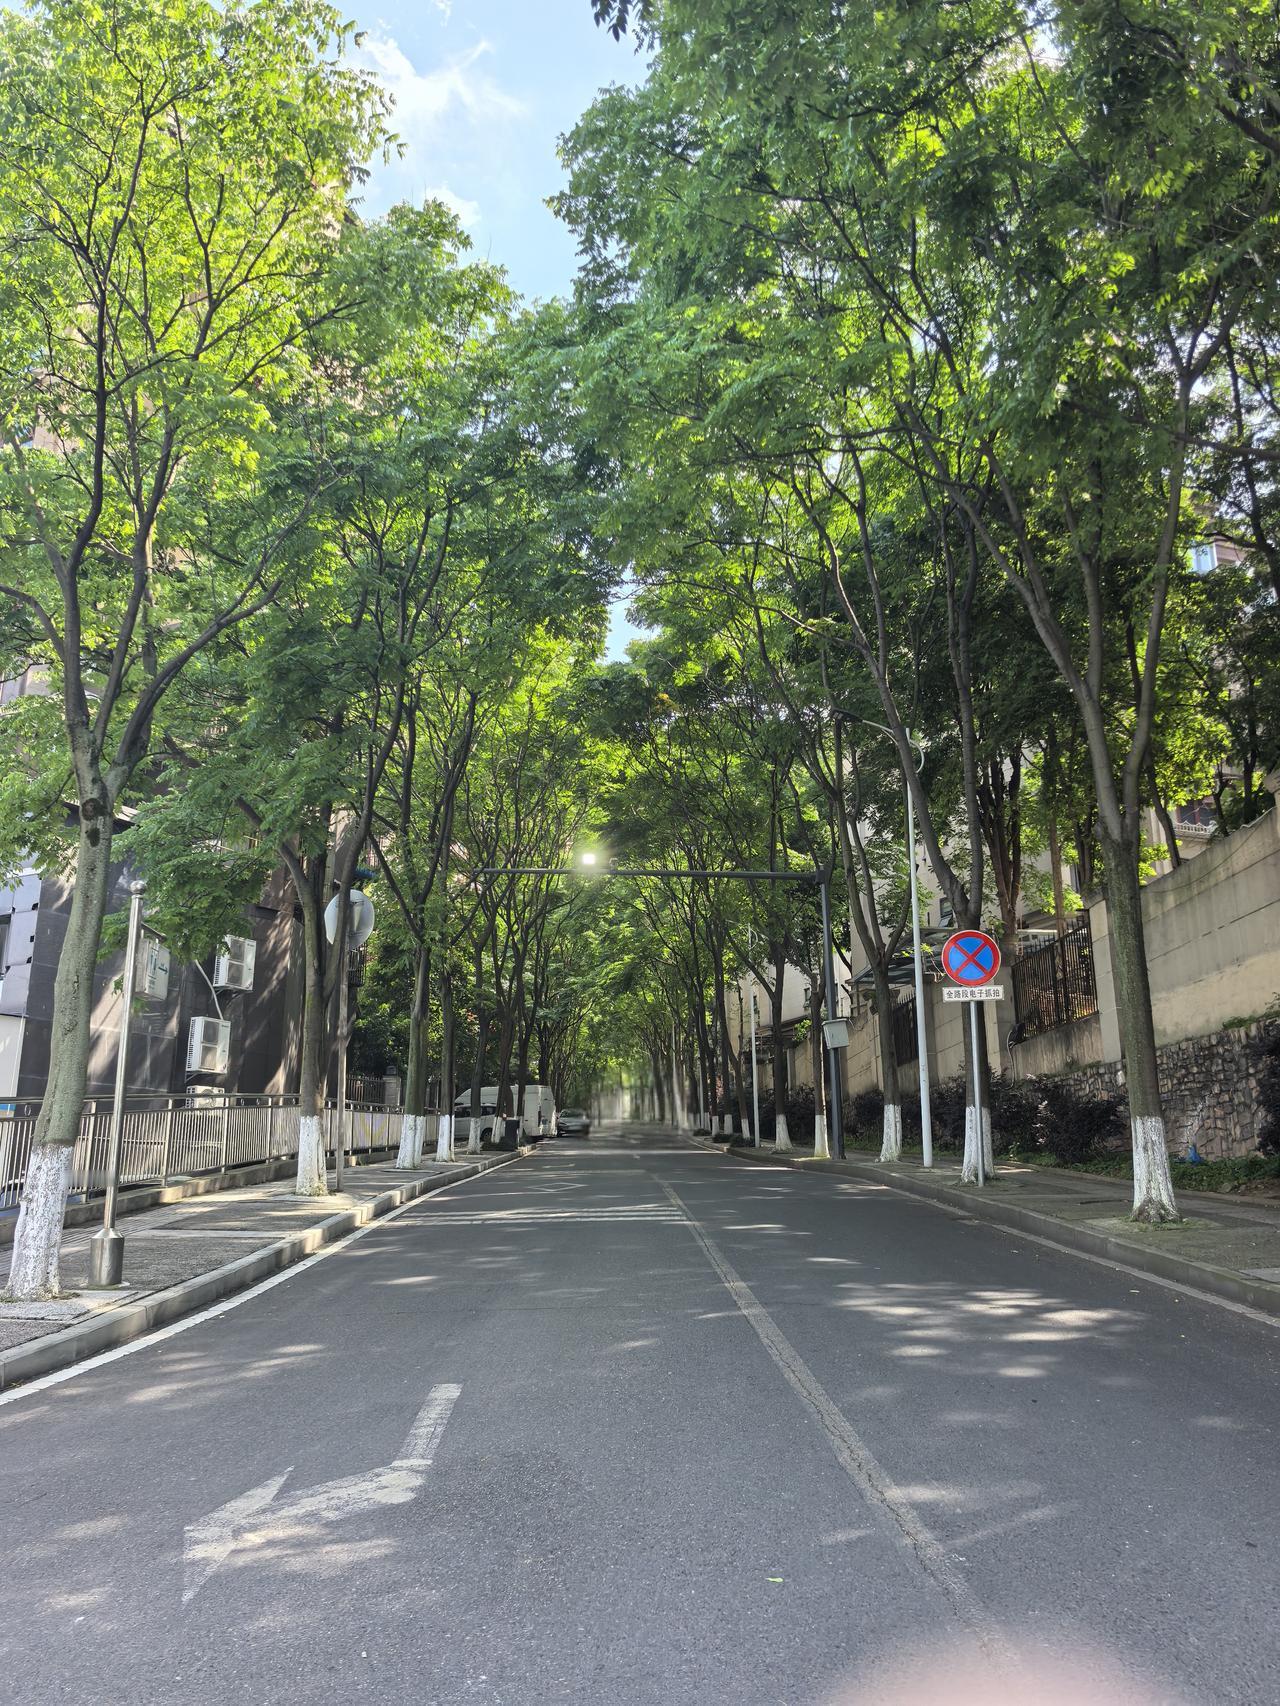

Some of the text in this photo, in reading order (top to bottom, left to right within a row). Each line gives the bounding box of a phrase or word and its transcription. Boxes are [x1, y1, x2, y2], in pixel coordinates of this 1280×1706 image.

[946, 989, 1000, 999] 全路段电子抓拍
